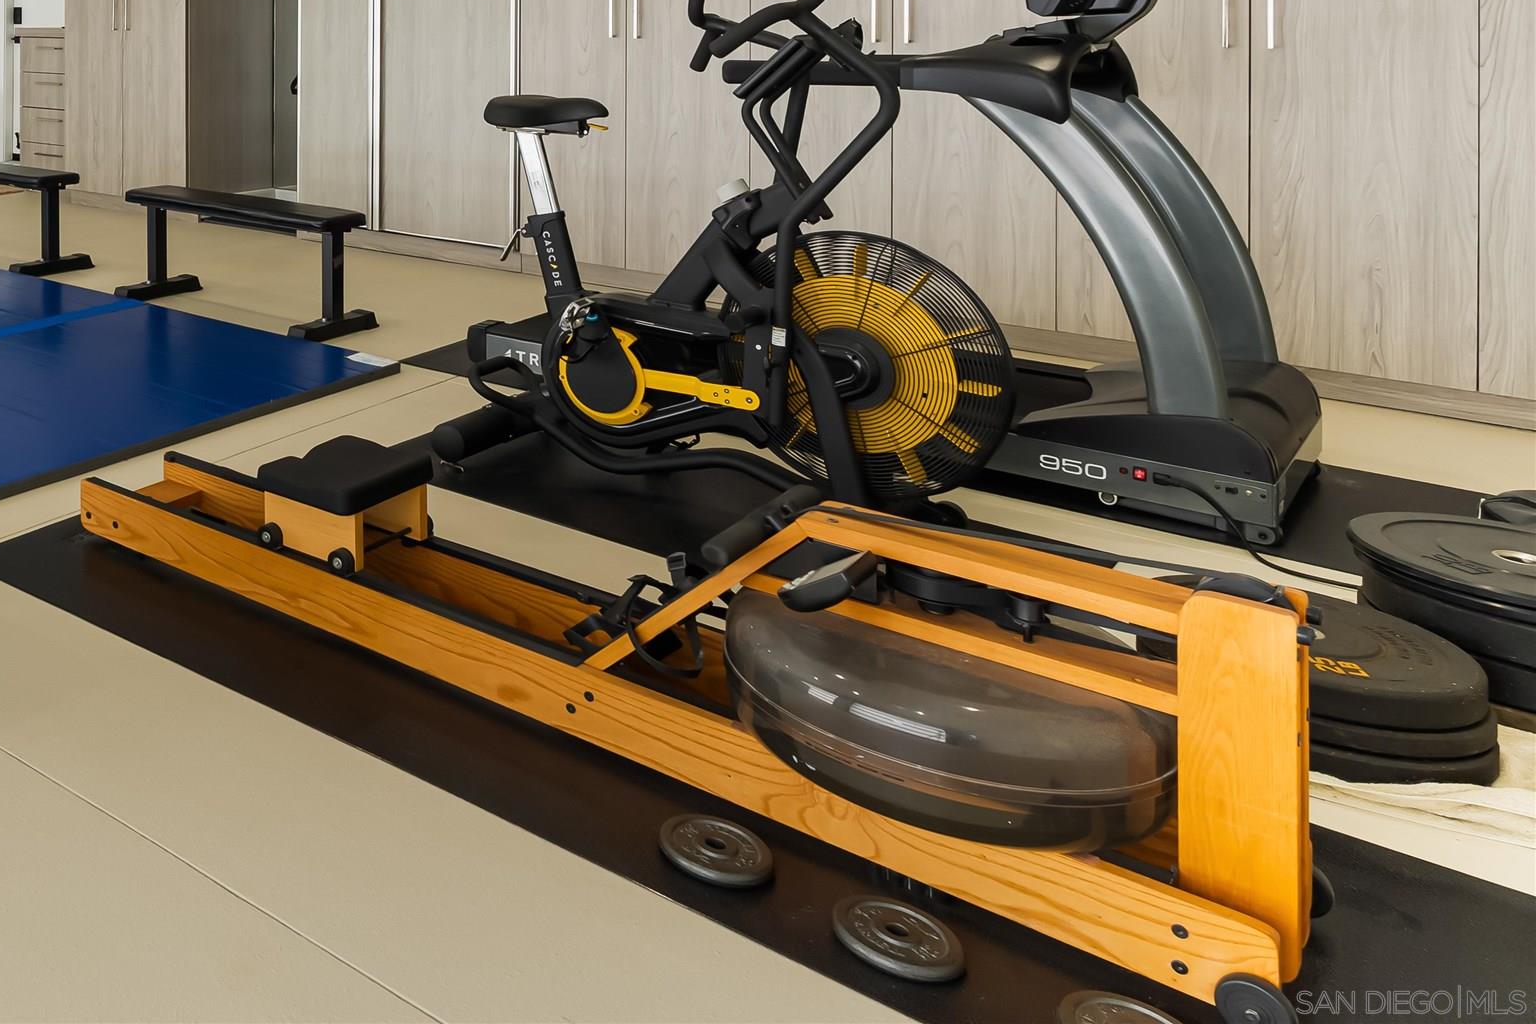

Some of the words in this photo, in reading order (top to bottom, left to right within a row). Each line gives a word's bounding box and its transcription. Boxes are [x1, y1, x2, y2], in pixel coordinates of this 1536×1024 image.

[1039, 454, 1107, 480] 950
[1308, 656, 1347, 675] 25
[1337, 661, 1370, 677] LB
